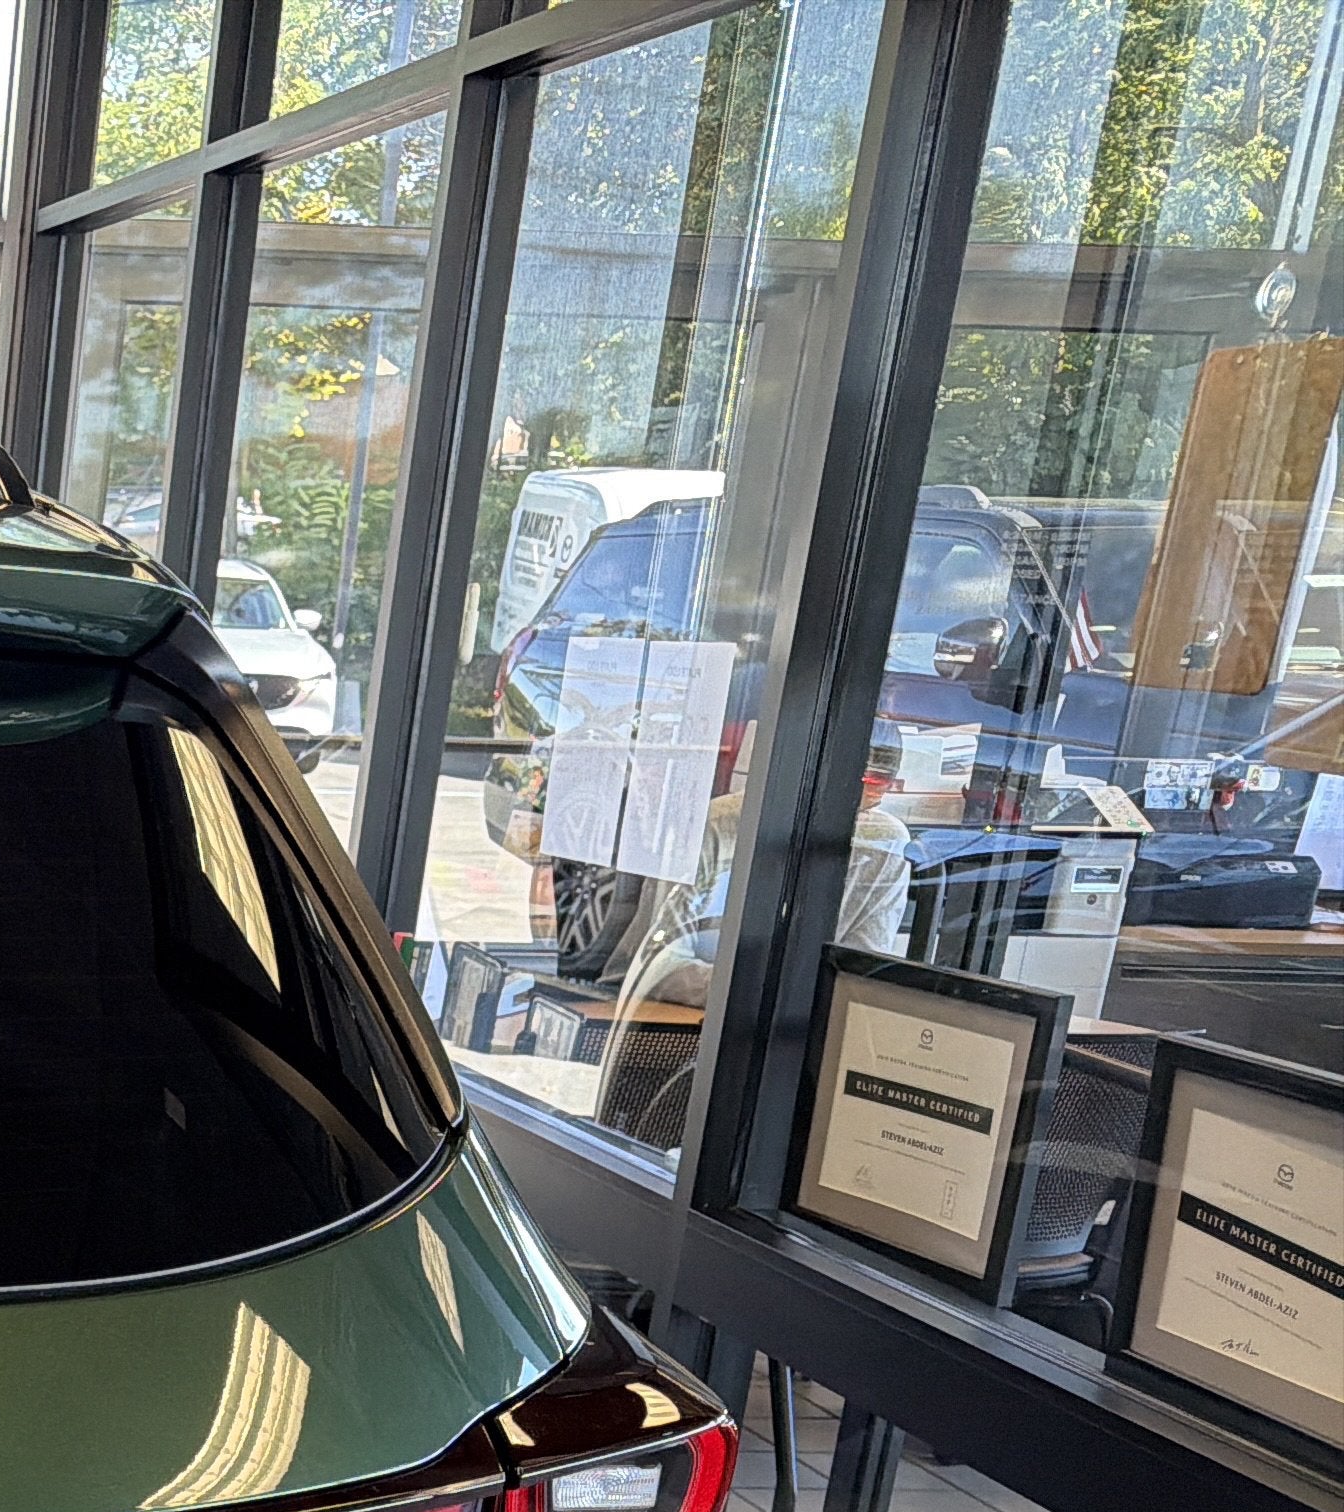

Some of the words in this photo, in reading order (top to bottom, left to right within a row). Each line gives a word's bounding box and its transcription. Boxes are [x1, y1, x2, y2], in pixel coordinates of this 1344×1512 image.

[856, 1080, 884, 1096] ELITE
[887, 1089, 926, 1108] MASTER
[929, 1100, 981, 1124] CERTIFIED
[881, 1130, 906, 1145] STEVEN
[1195, 1208, 1226, 1231] ELITE
[1229, 1225, 1277, 1256] MASTER
[1281, 1250, 1344, 1288] CERTIFIED
[1215, 1271, 1247, 1293] STEVEN
[1247, 1288, 1300, 1320] ABDEL-AZIZ
